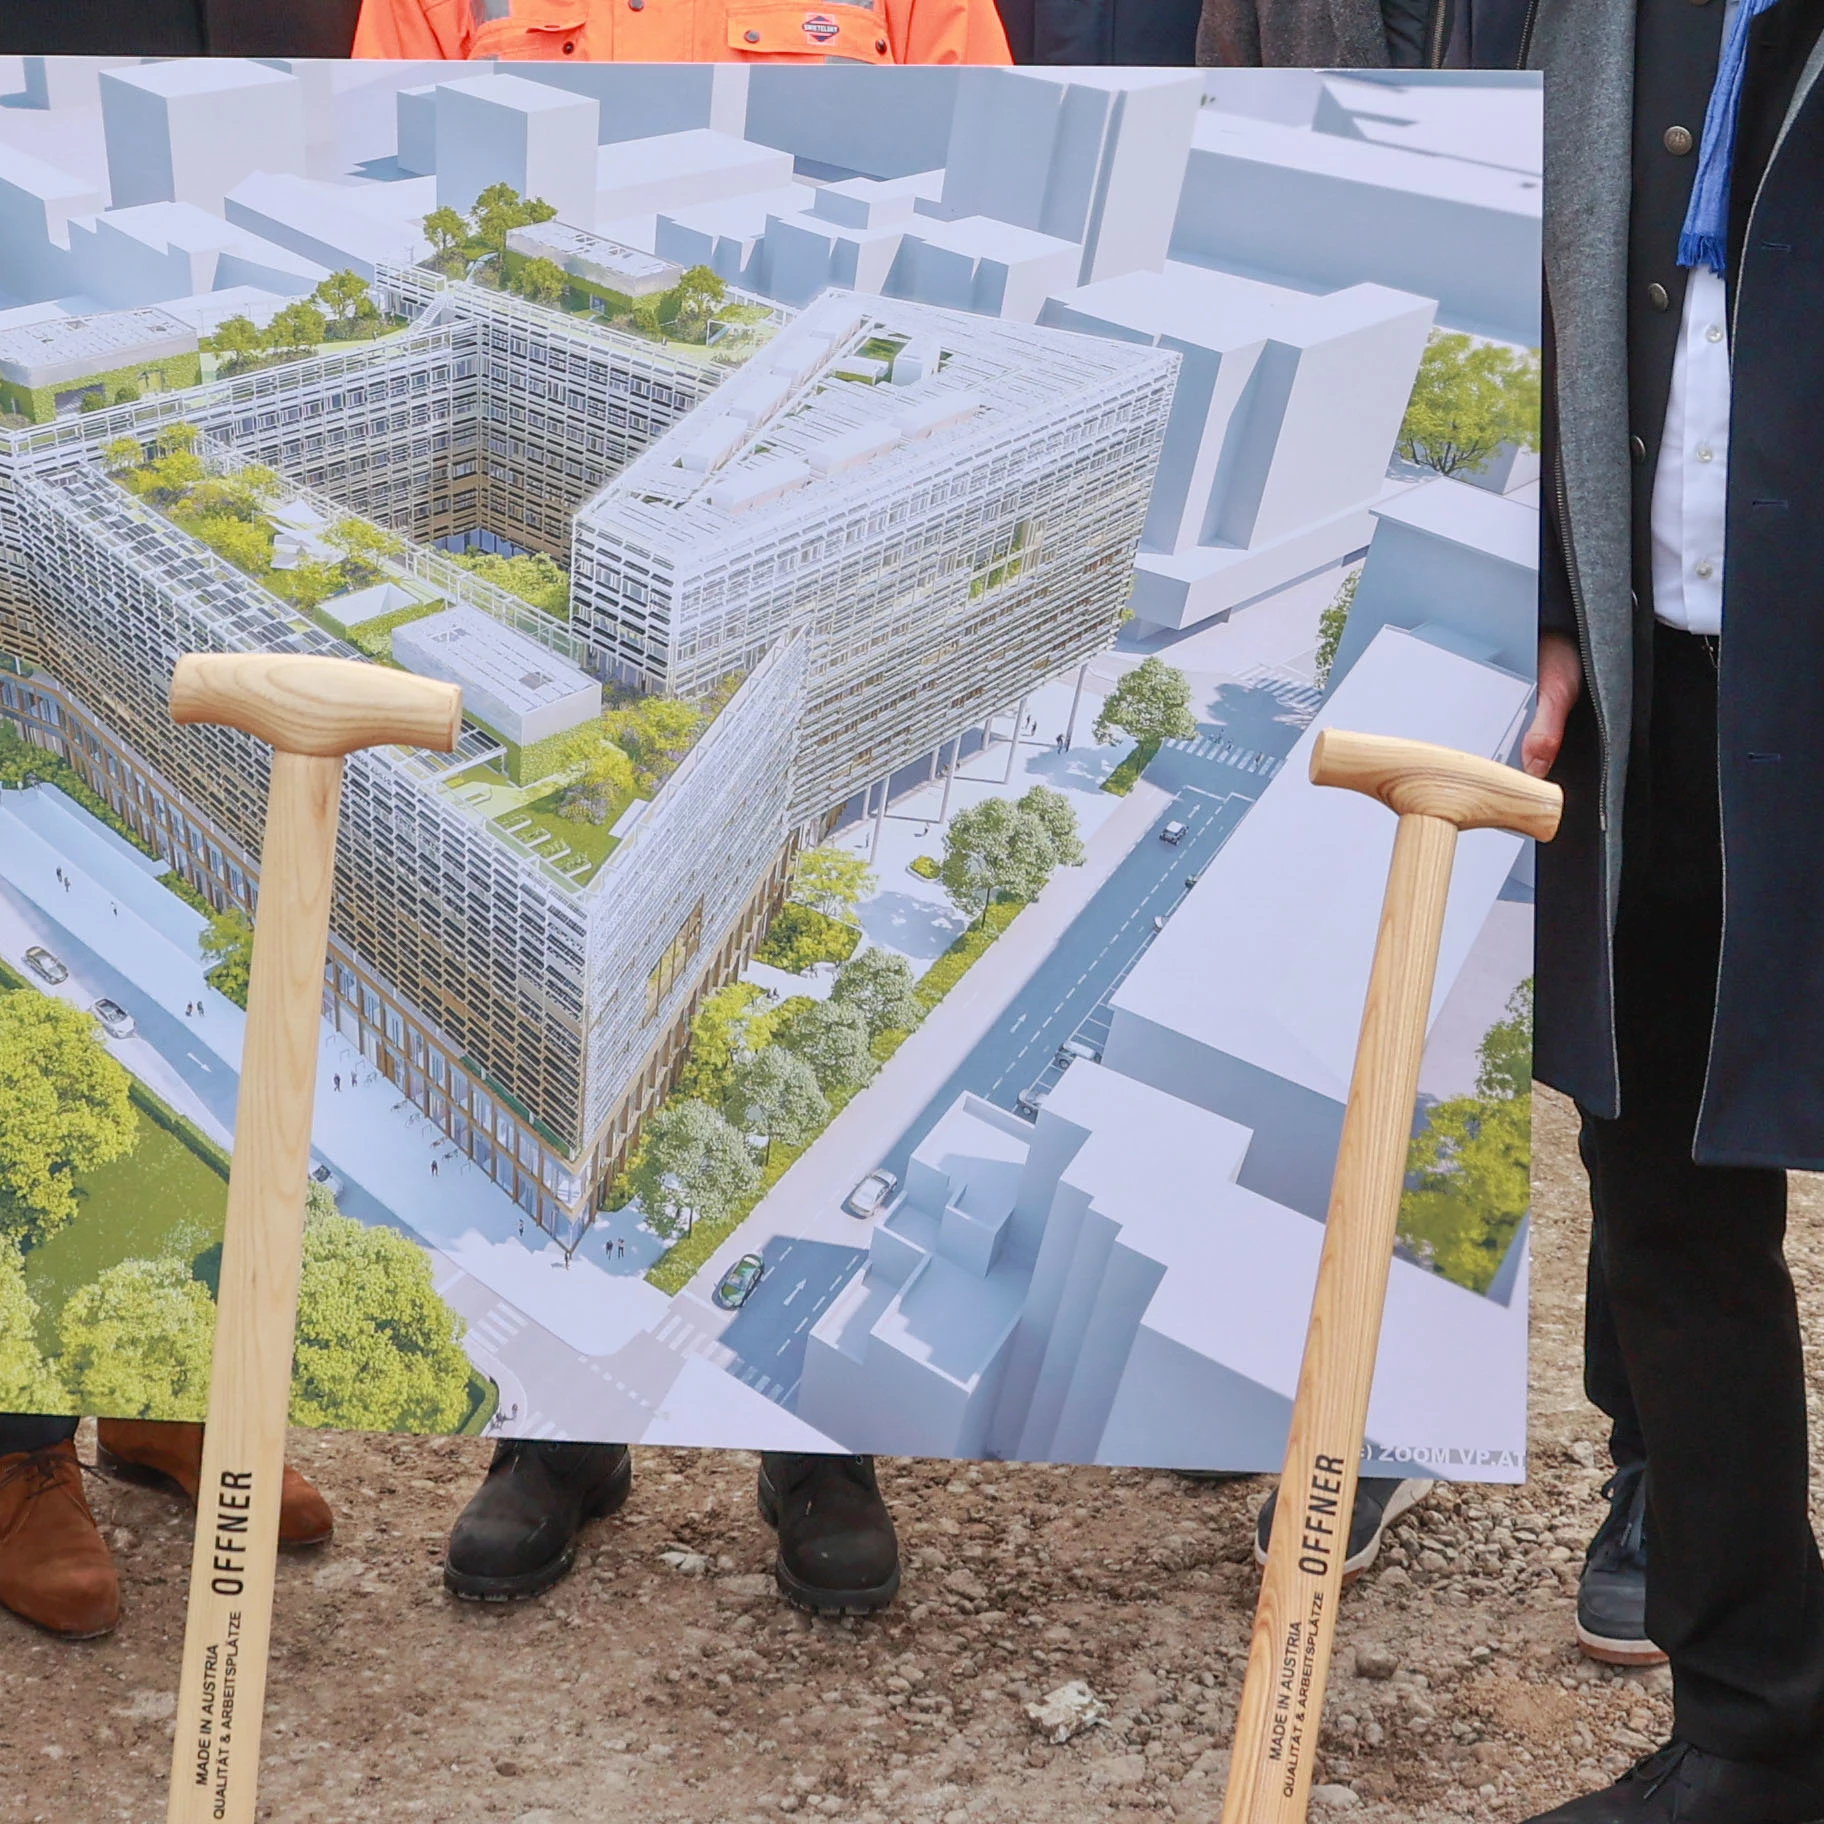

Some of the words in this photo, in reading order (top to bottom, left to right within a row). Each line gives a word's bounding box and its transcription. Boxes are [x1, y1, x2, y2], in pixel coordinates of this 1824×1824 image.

[1379, 1445, 1450, 1464] ZOOM
[211, 1470, 253, 1596] OFFNER
[1298, 1454, 1345, 1577] OFFNER
[204, 1643, 219, 1716] AUSTRIA
[1282, 1621, 1302, 1694] AUSTRIA
[200, 1718, 213, 1734] IN
[1279, 1695, 1289, 1710] IN
[1296, 1712, 1306, 1723] &
[196, 1736, 211, 1785] MADE
[220, 1734, 231, 1744] &
[1269, 1714, 1288, 1761] MADE
